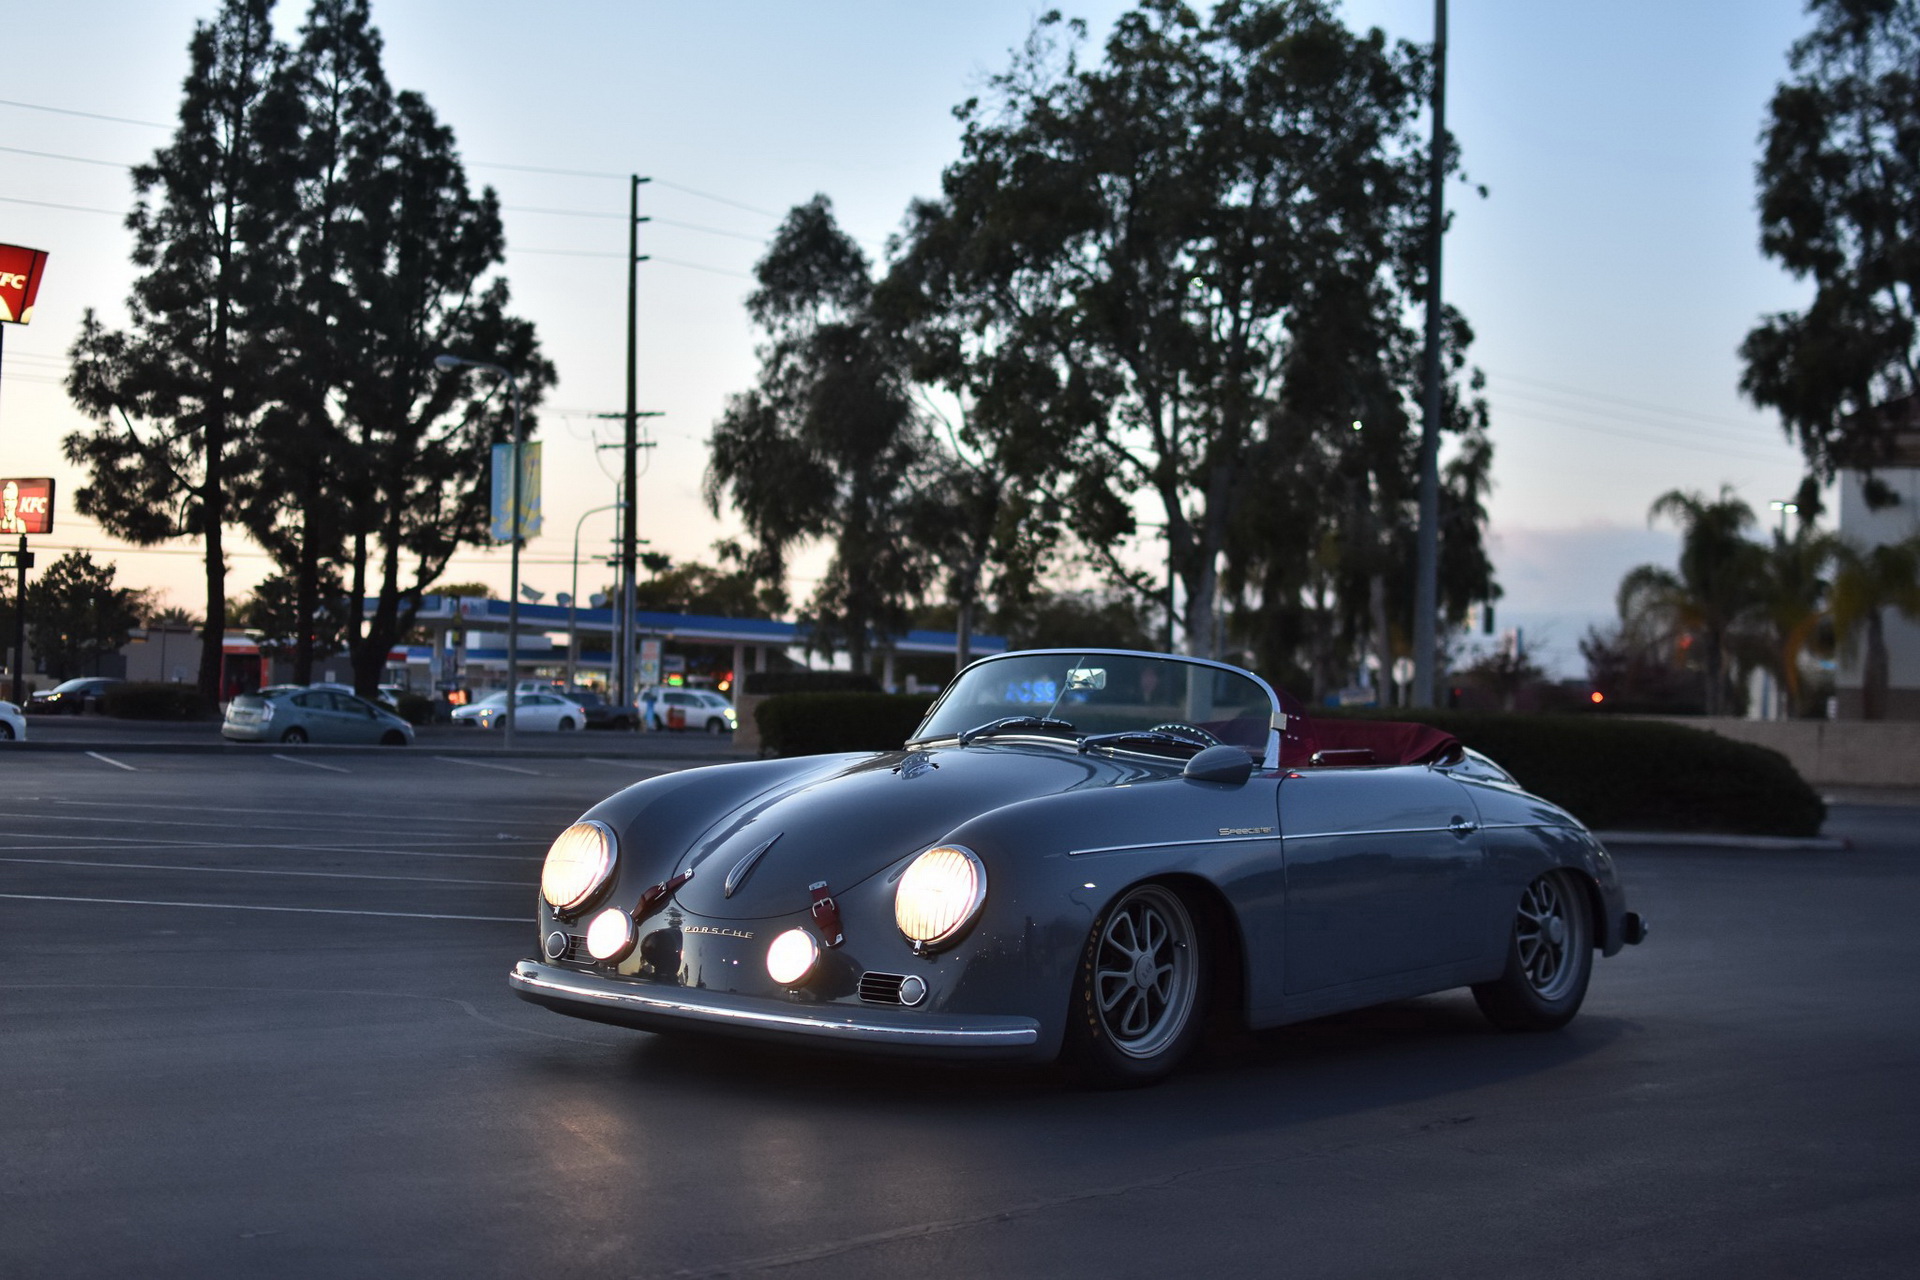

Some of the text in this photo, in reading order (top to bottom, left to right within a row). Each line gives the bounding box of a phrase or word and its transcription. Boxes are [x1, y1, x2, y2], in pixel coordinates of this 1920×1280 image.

[0, 271, 26, 289] FC
[19, 496, 48, 513] KFC
[684, 926, 754, 939] PORSCHE
